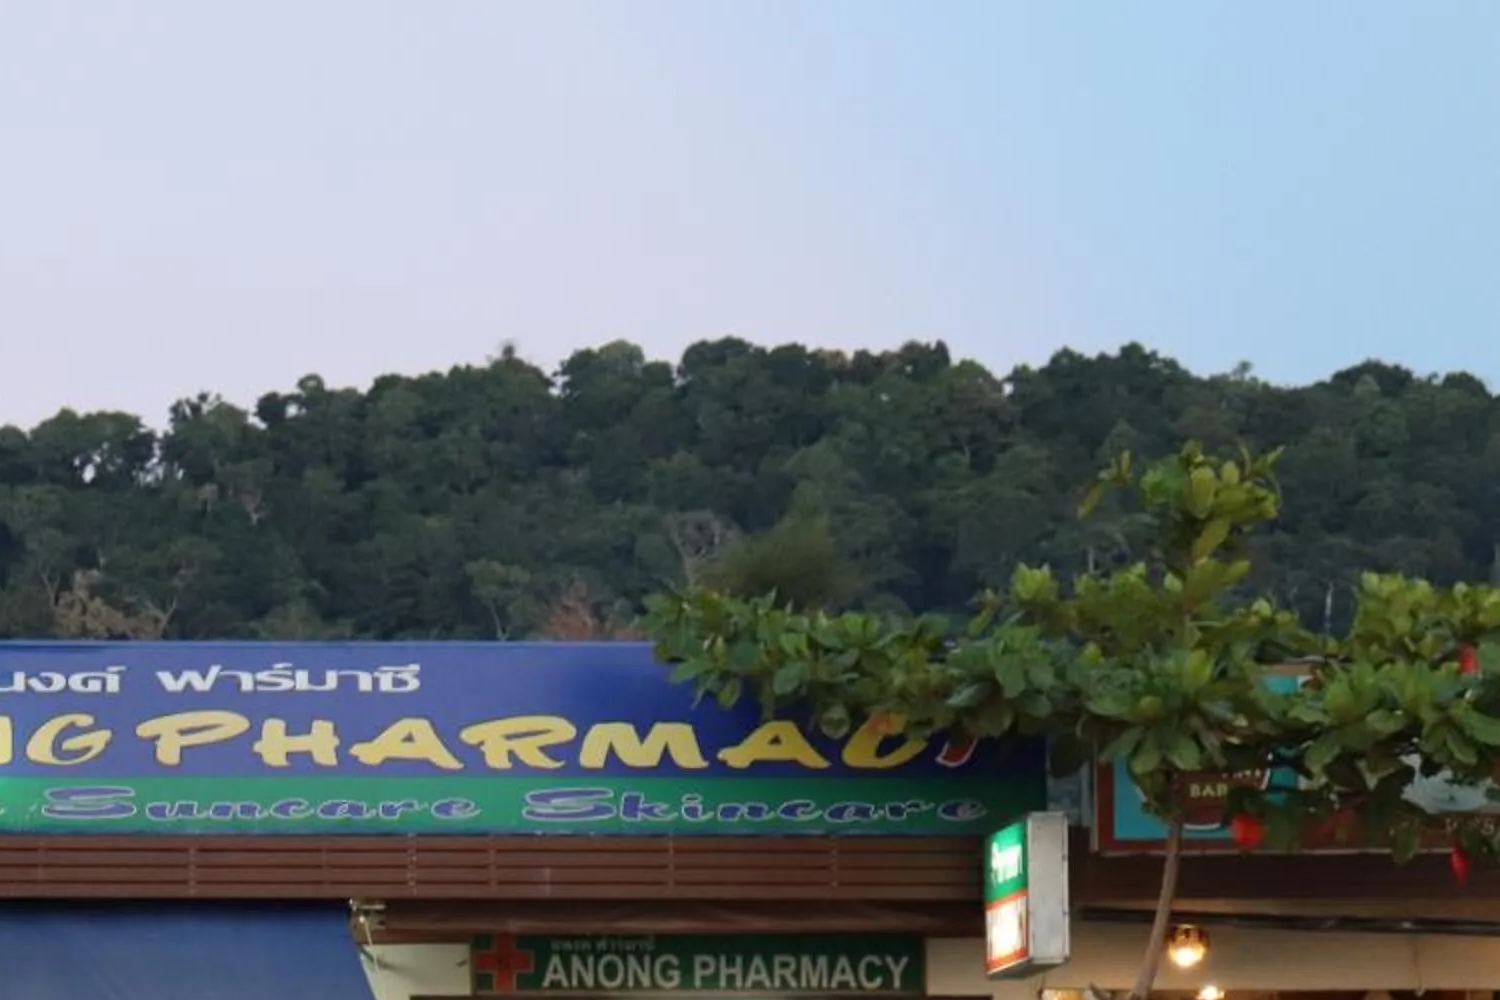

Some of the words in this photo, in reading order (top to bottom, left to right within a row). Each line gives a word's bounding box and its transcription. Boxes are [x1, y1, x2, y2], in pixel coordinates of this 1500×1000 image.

[134, 710, 978, 770] PHARMAC
[43, 786, 482, 819] Suncare
[521, 788, 990, 822] Skincare
[542, 954, 681, 989] ANONG
[693, 955, 909, 989] PHARMACY
